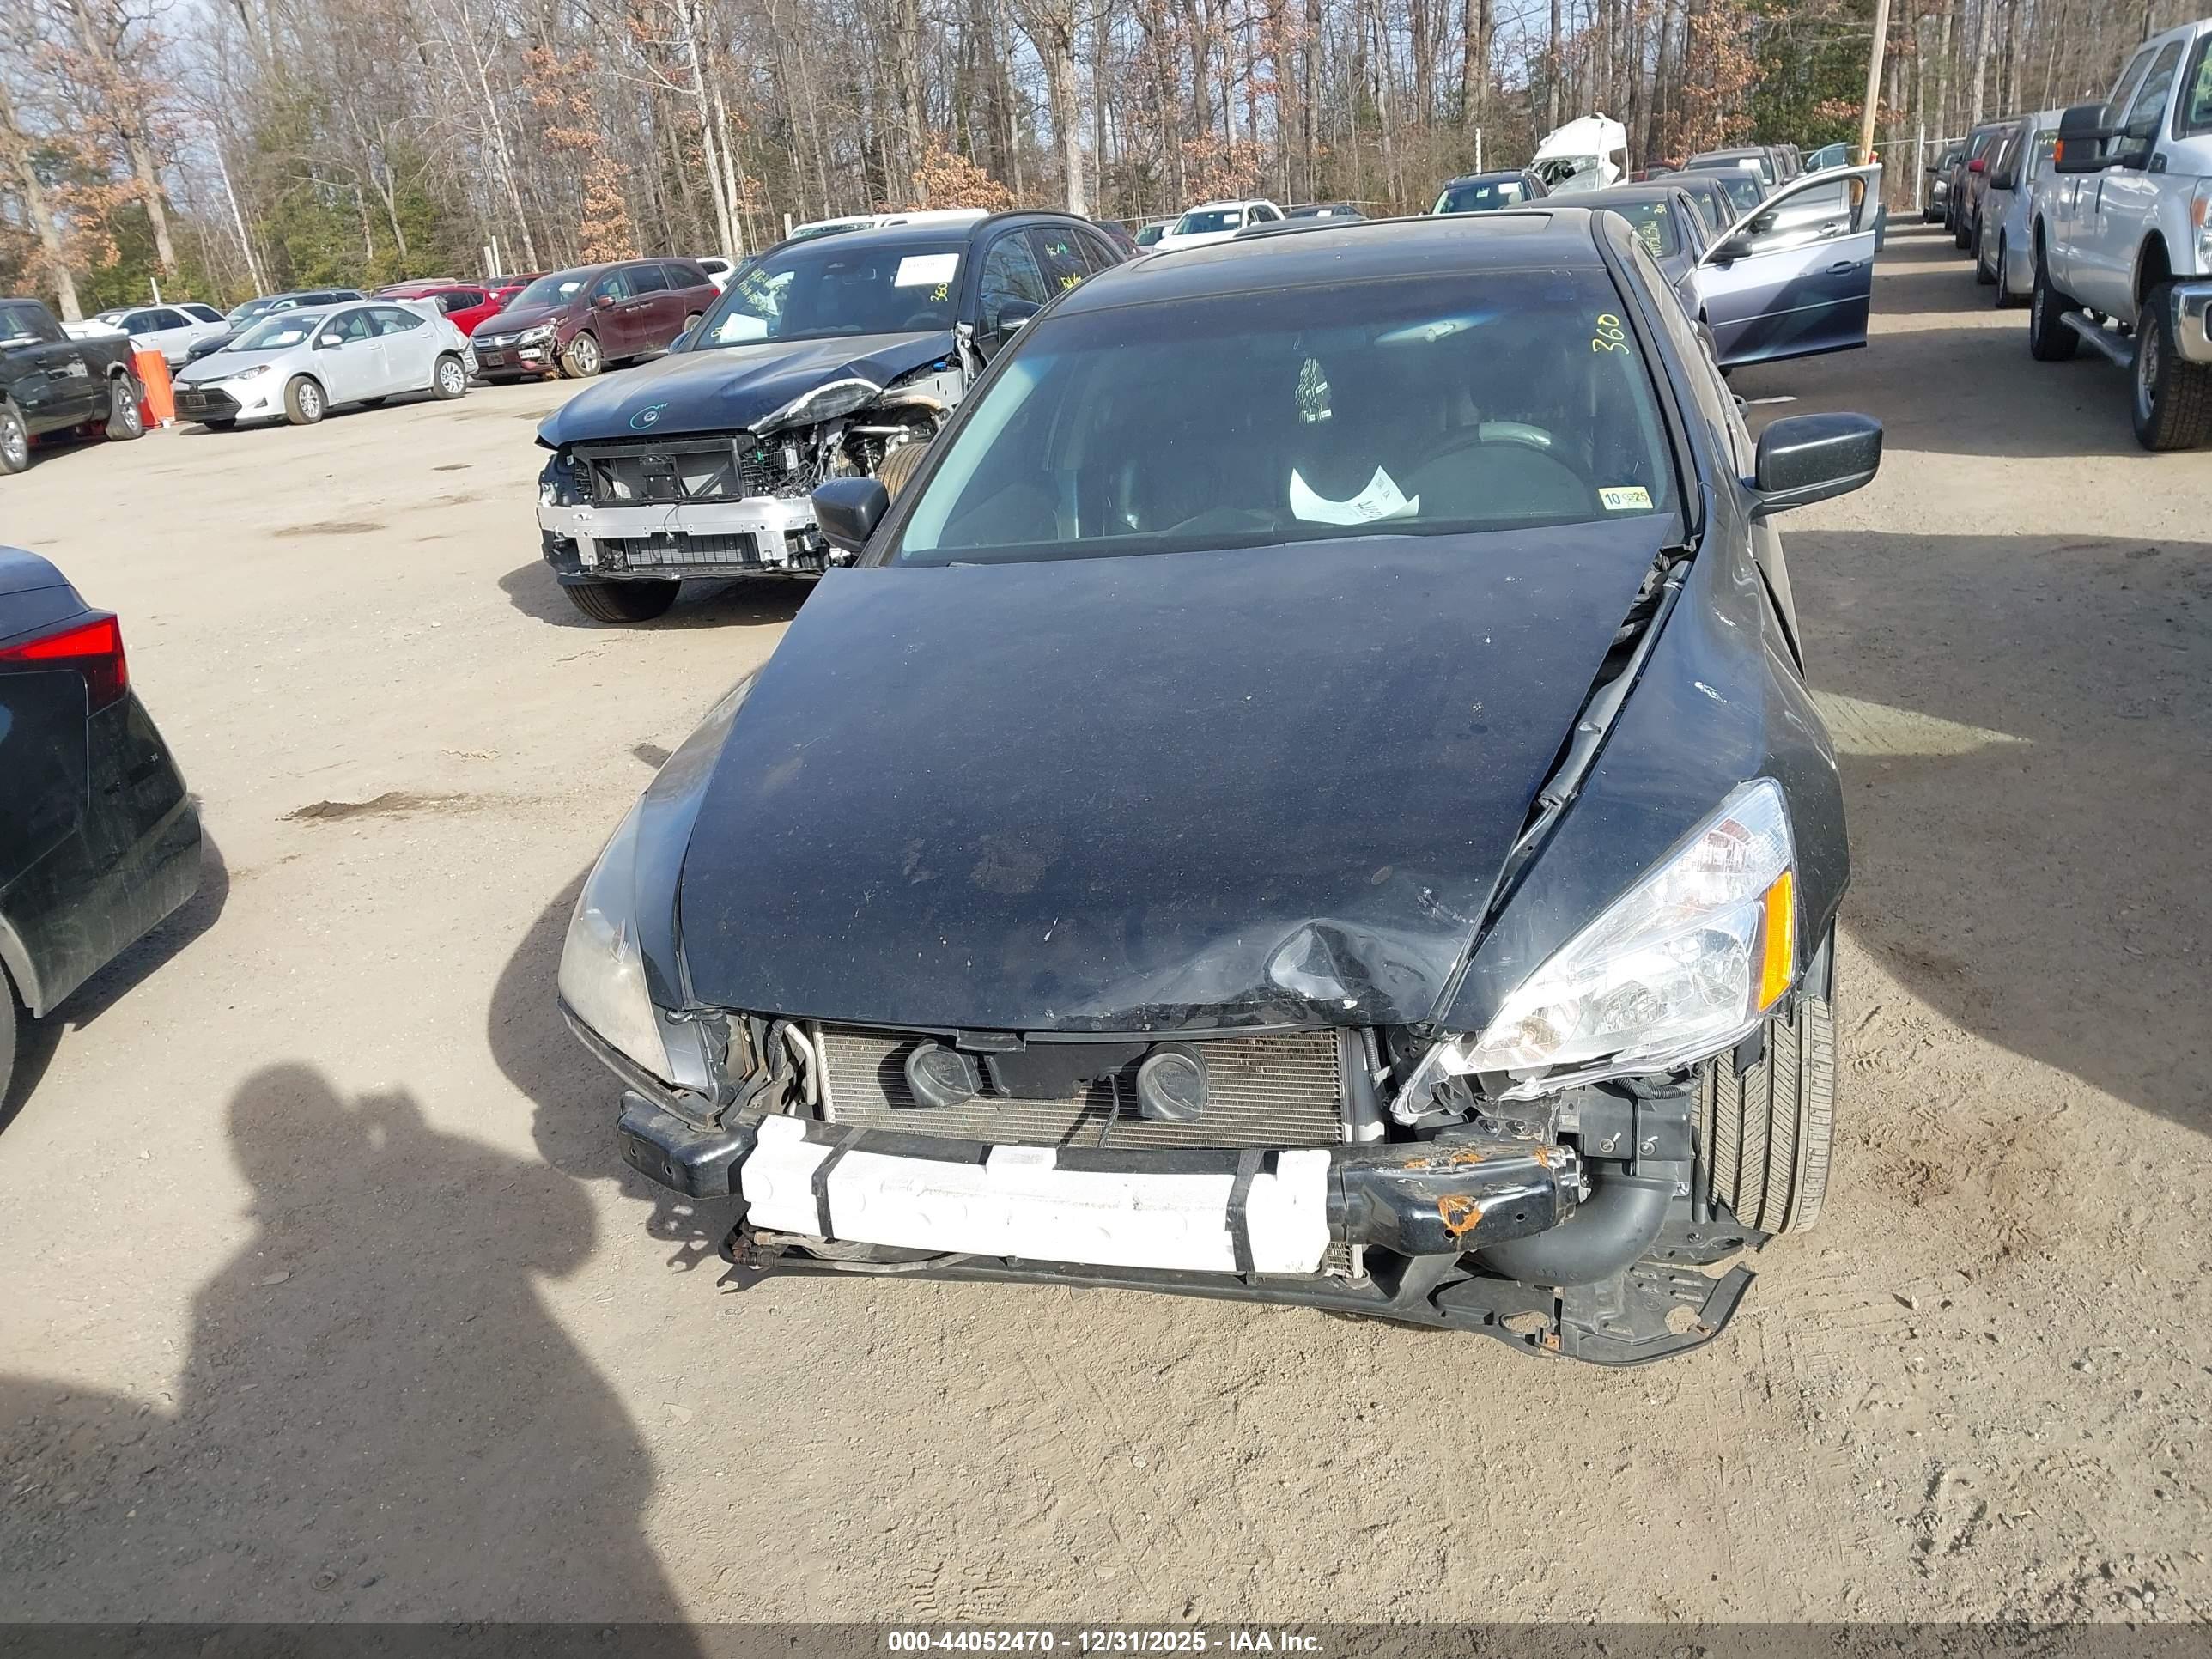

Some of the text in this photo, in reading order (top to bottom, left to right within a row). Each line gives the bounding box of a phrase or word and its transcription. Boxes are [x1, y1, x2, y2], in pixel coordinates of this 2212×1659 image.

[930, 283, 949, 302] 360
[1592, 313, 1630, 355] 360
[1605, 492, 1649, 505] 10 25
